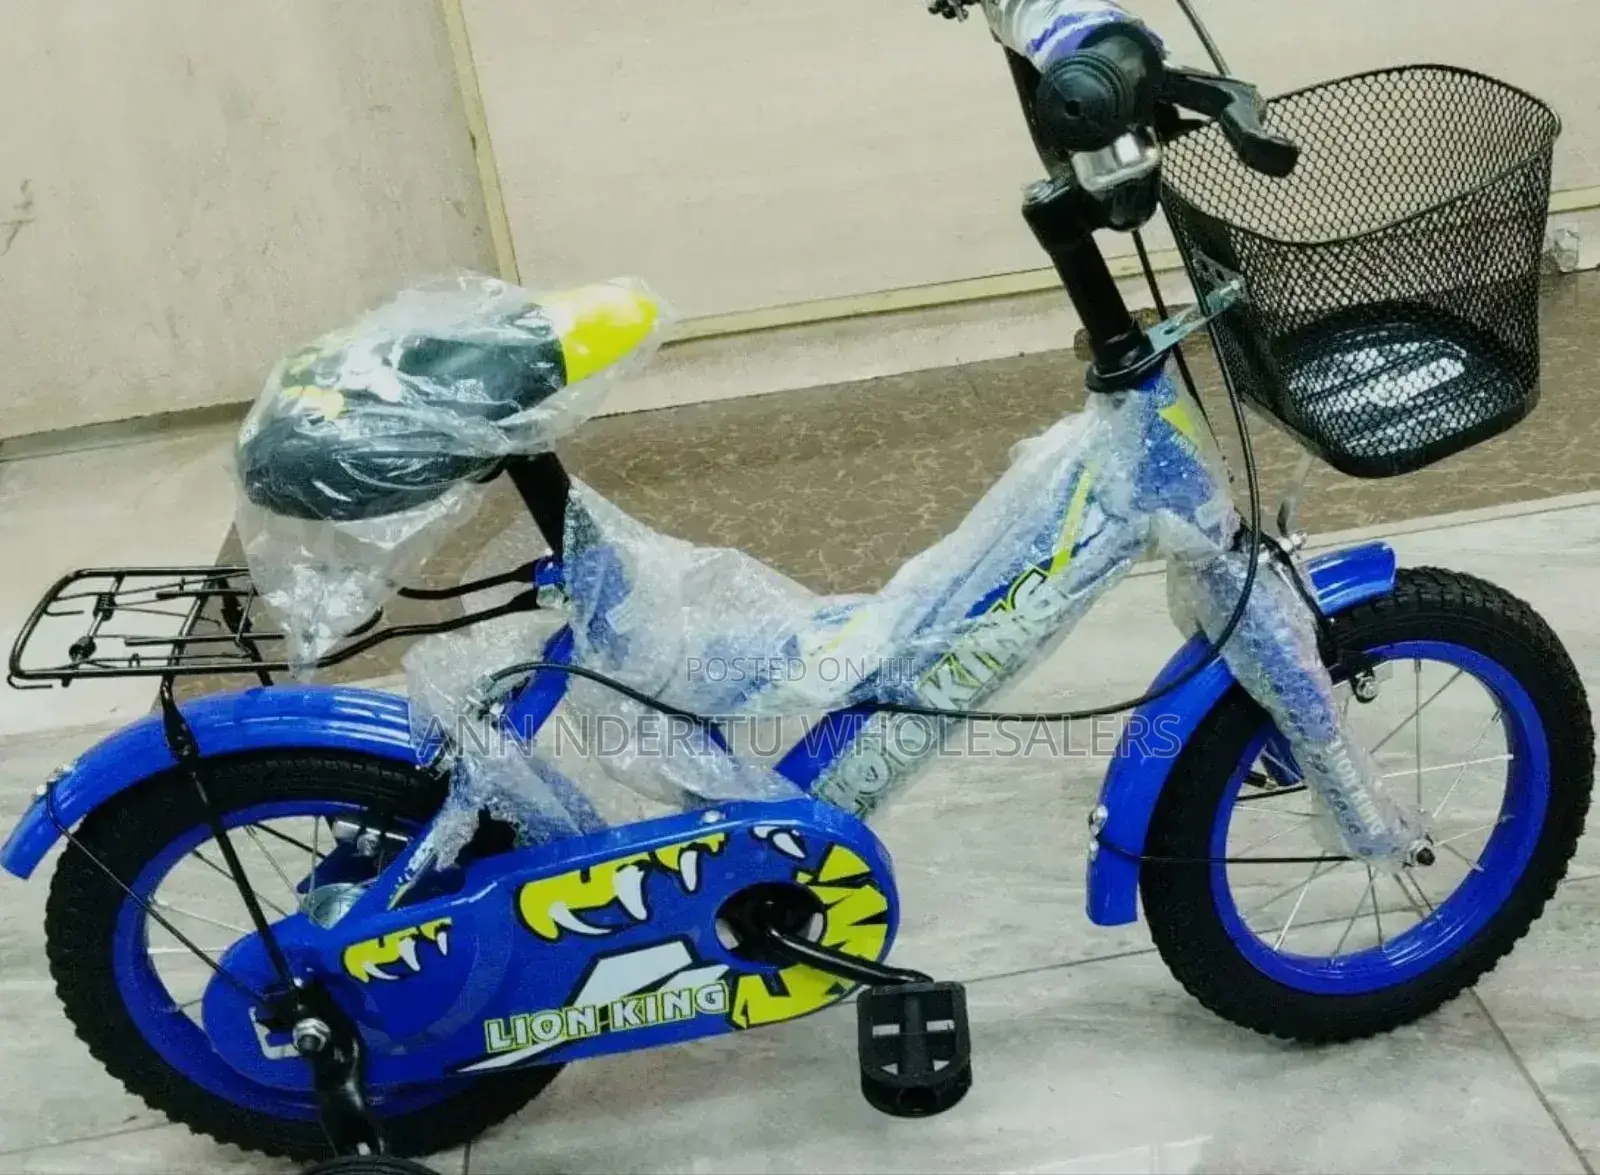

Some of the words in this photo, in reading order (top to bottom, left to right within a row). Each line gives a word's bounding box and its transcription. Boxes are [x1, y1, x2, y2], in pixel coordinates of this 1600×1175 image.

[916, 571, 1069, 713] KING
[484, 1005, 600, 1053] LION
[608, 979, 730, 1033] KING
